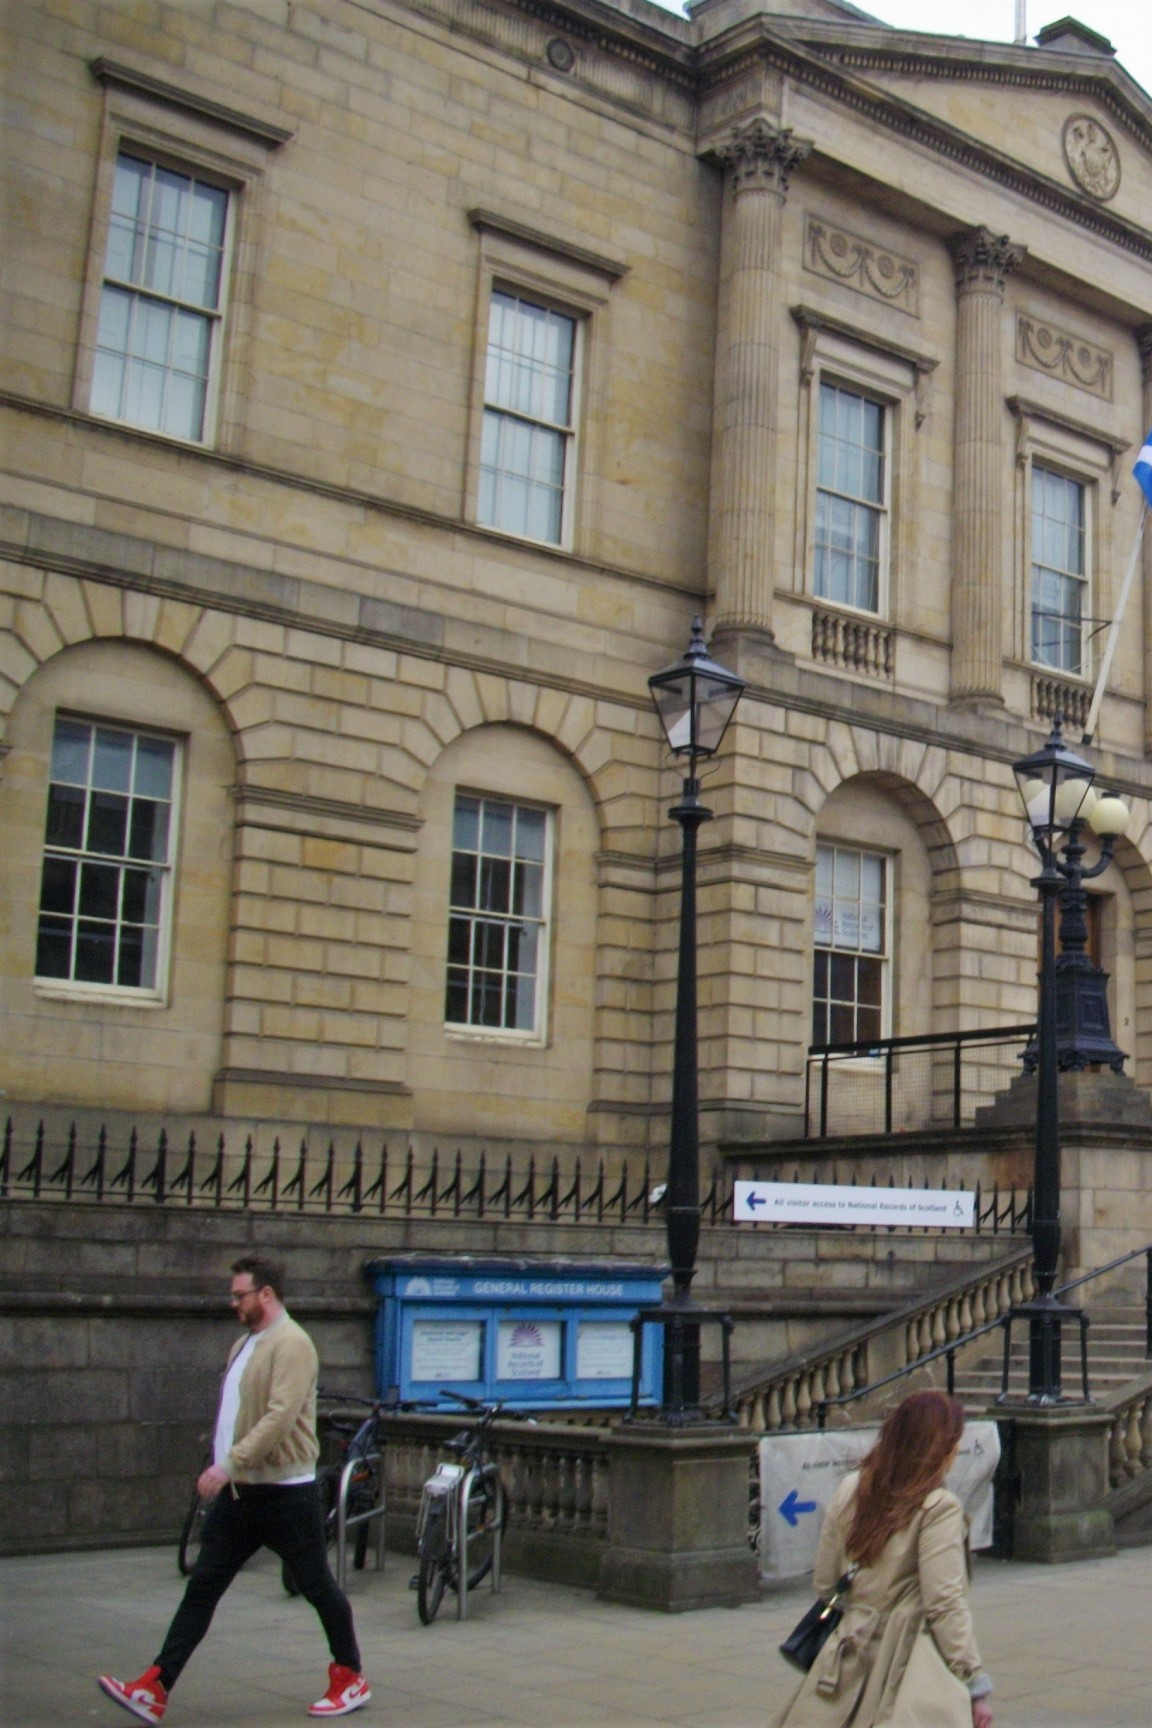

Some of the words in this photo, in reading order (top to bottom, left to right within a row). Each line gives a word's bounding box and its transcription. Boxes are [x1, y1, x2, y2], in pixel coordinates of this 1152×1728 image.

[786, 1198, 810, 1207] visitor
[812, 1200, 836, 1208] access
[838, 1200, 846, 1209] to
[847, 1201, 878, 1210] National
[879, 1202, 907, 1211] Records
[908, 1202, 916, 1211] of
[917, 1203, 947, 1212] Scotland
[474, 1281, 527, 1295] GENERAL
[529, 1282, 584, 1296] REGISTER
[586, 1283, 624, 1297] HOUSE
